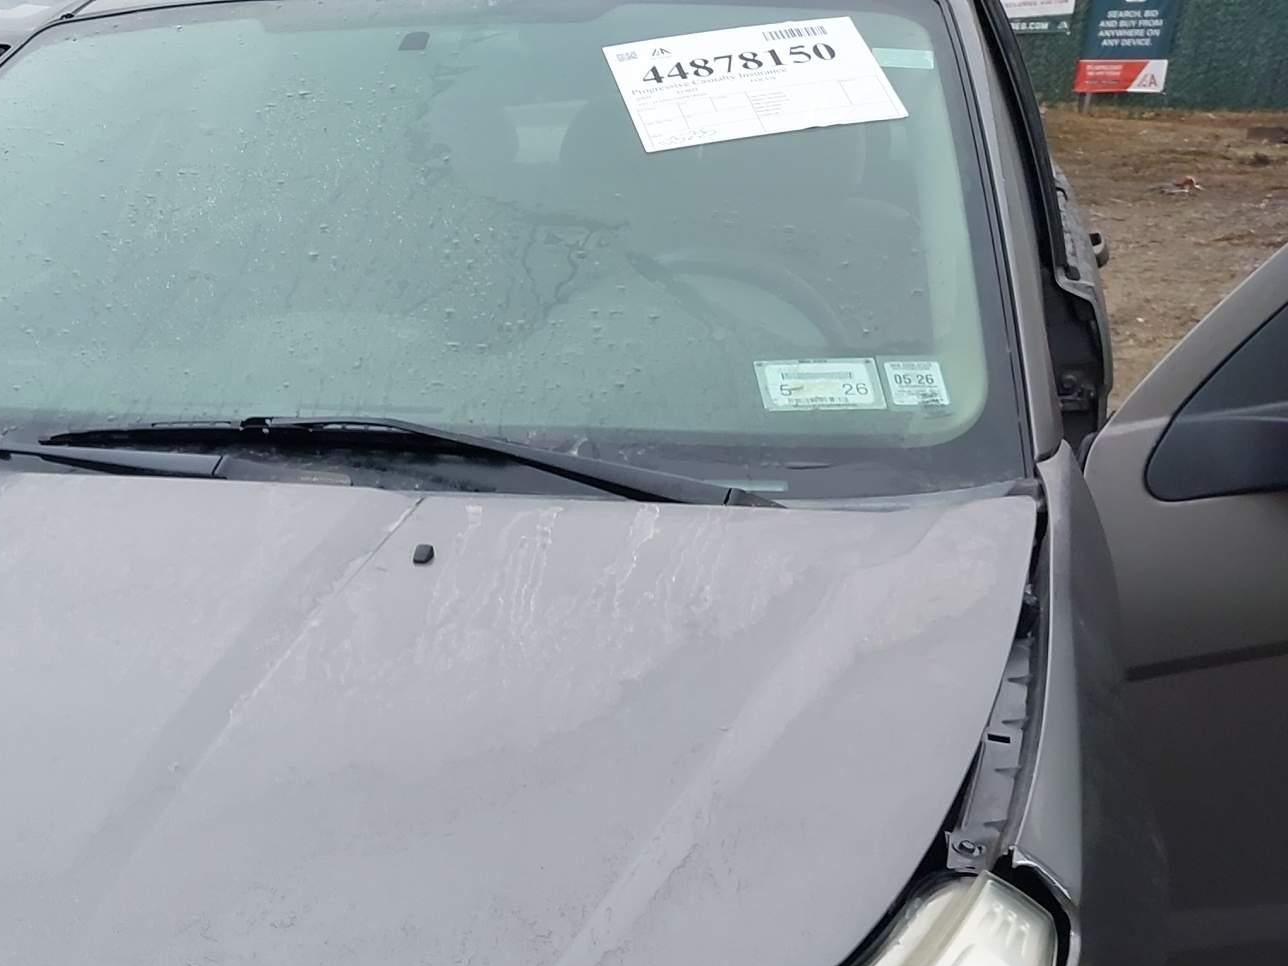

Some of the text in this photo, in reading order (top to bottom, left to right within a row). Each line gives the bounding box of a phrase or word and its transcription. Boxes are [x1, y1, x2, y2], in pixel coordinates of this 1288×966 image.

[1143, 9, 1159, 18] BID
[1099, 20, 1118, 28] AND
[1138, 19, 1164, 27] FROM
[1097, 28, 1161, 37] ANYWHERE ON
[1101, 38, 1120, 47] ANY
[642, 42, 836, 84] 44878150
[631, 67, 788, 97] Progressive Casualty Insurance
[894, 374, 935, 385] 05 26
[842, 383, 869, 396] 26
